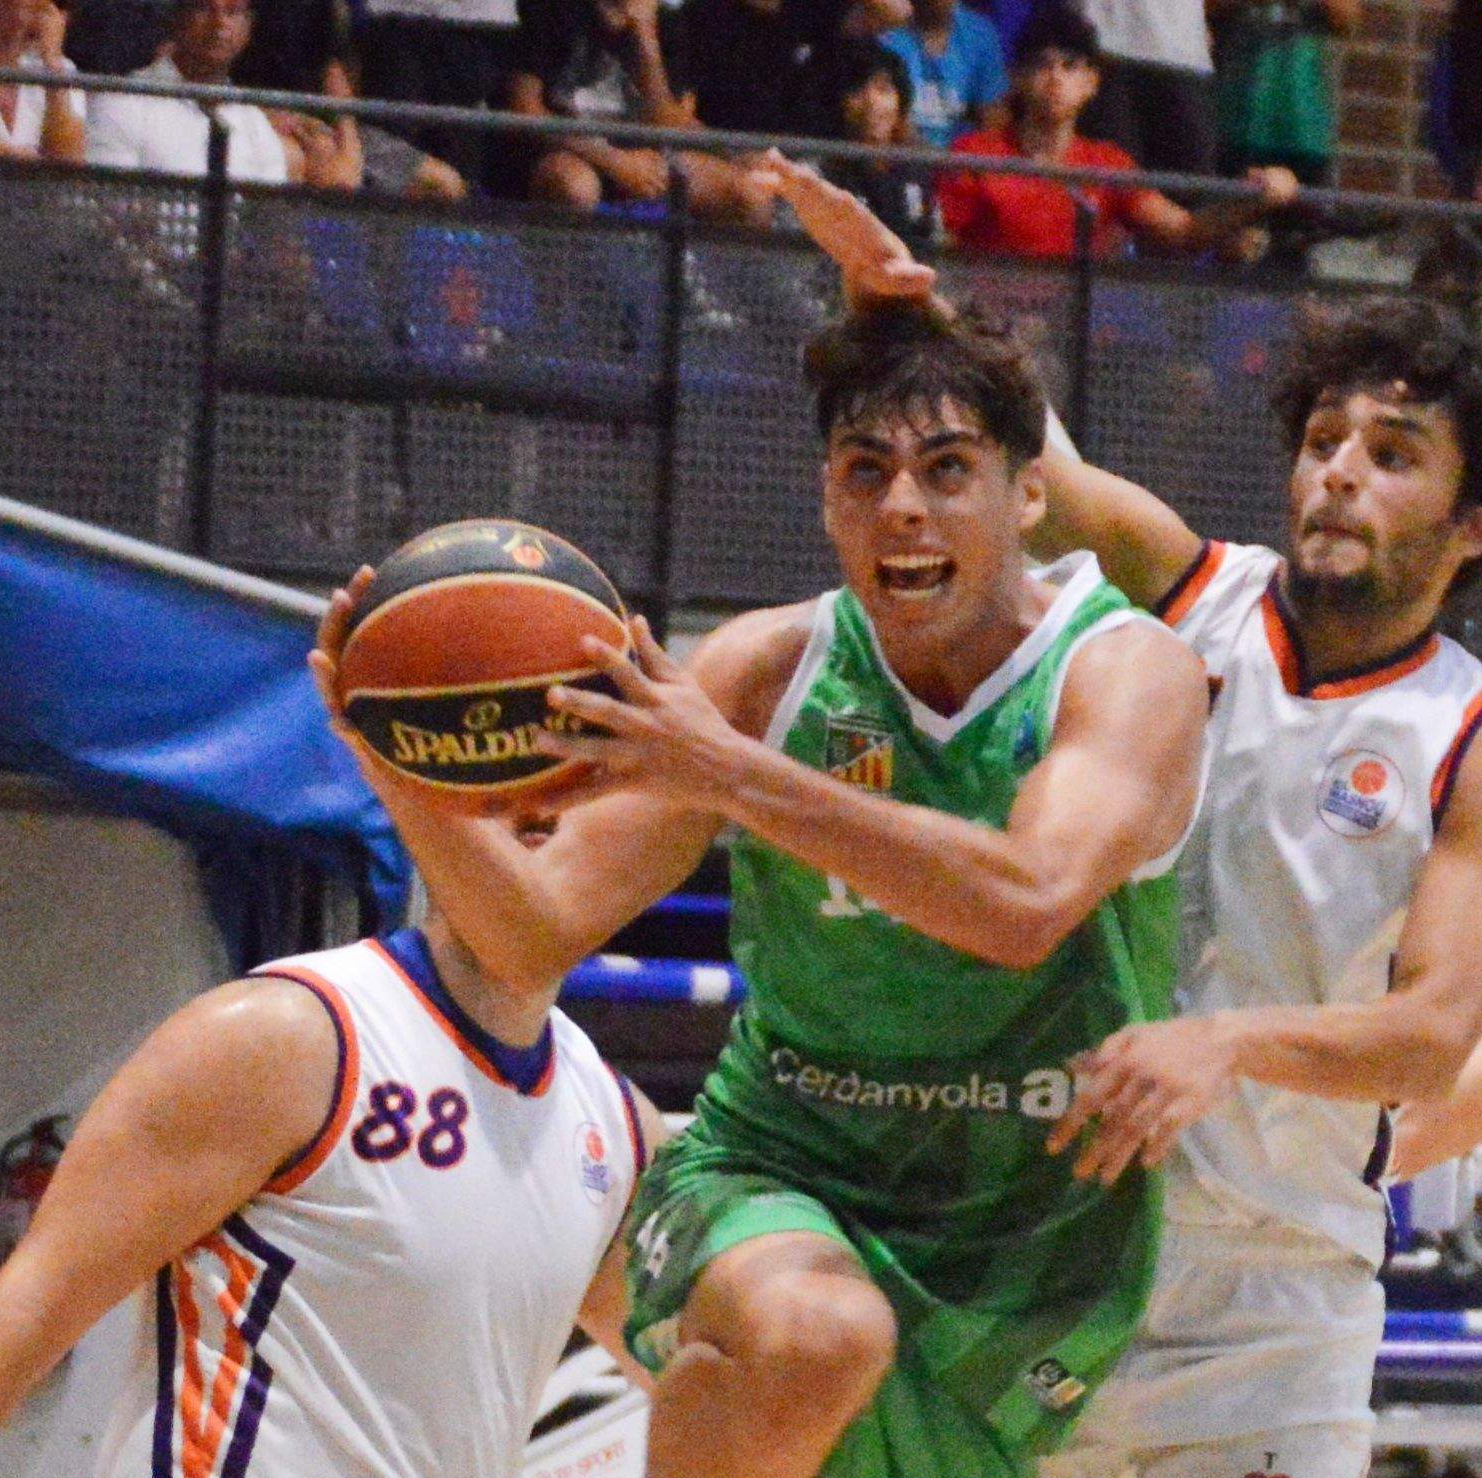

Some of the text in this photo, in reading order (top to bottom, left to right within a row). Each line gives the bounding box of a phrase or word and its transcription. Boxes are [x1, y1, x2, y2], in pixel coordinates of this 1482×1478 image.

[391, 712, 582, 765] SPALDI
[770, 1048, 1009, 1112] Cerdanyola
[351, 1079, 469, 1171] 88
[1264, 1451, 1277, 1470] T
